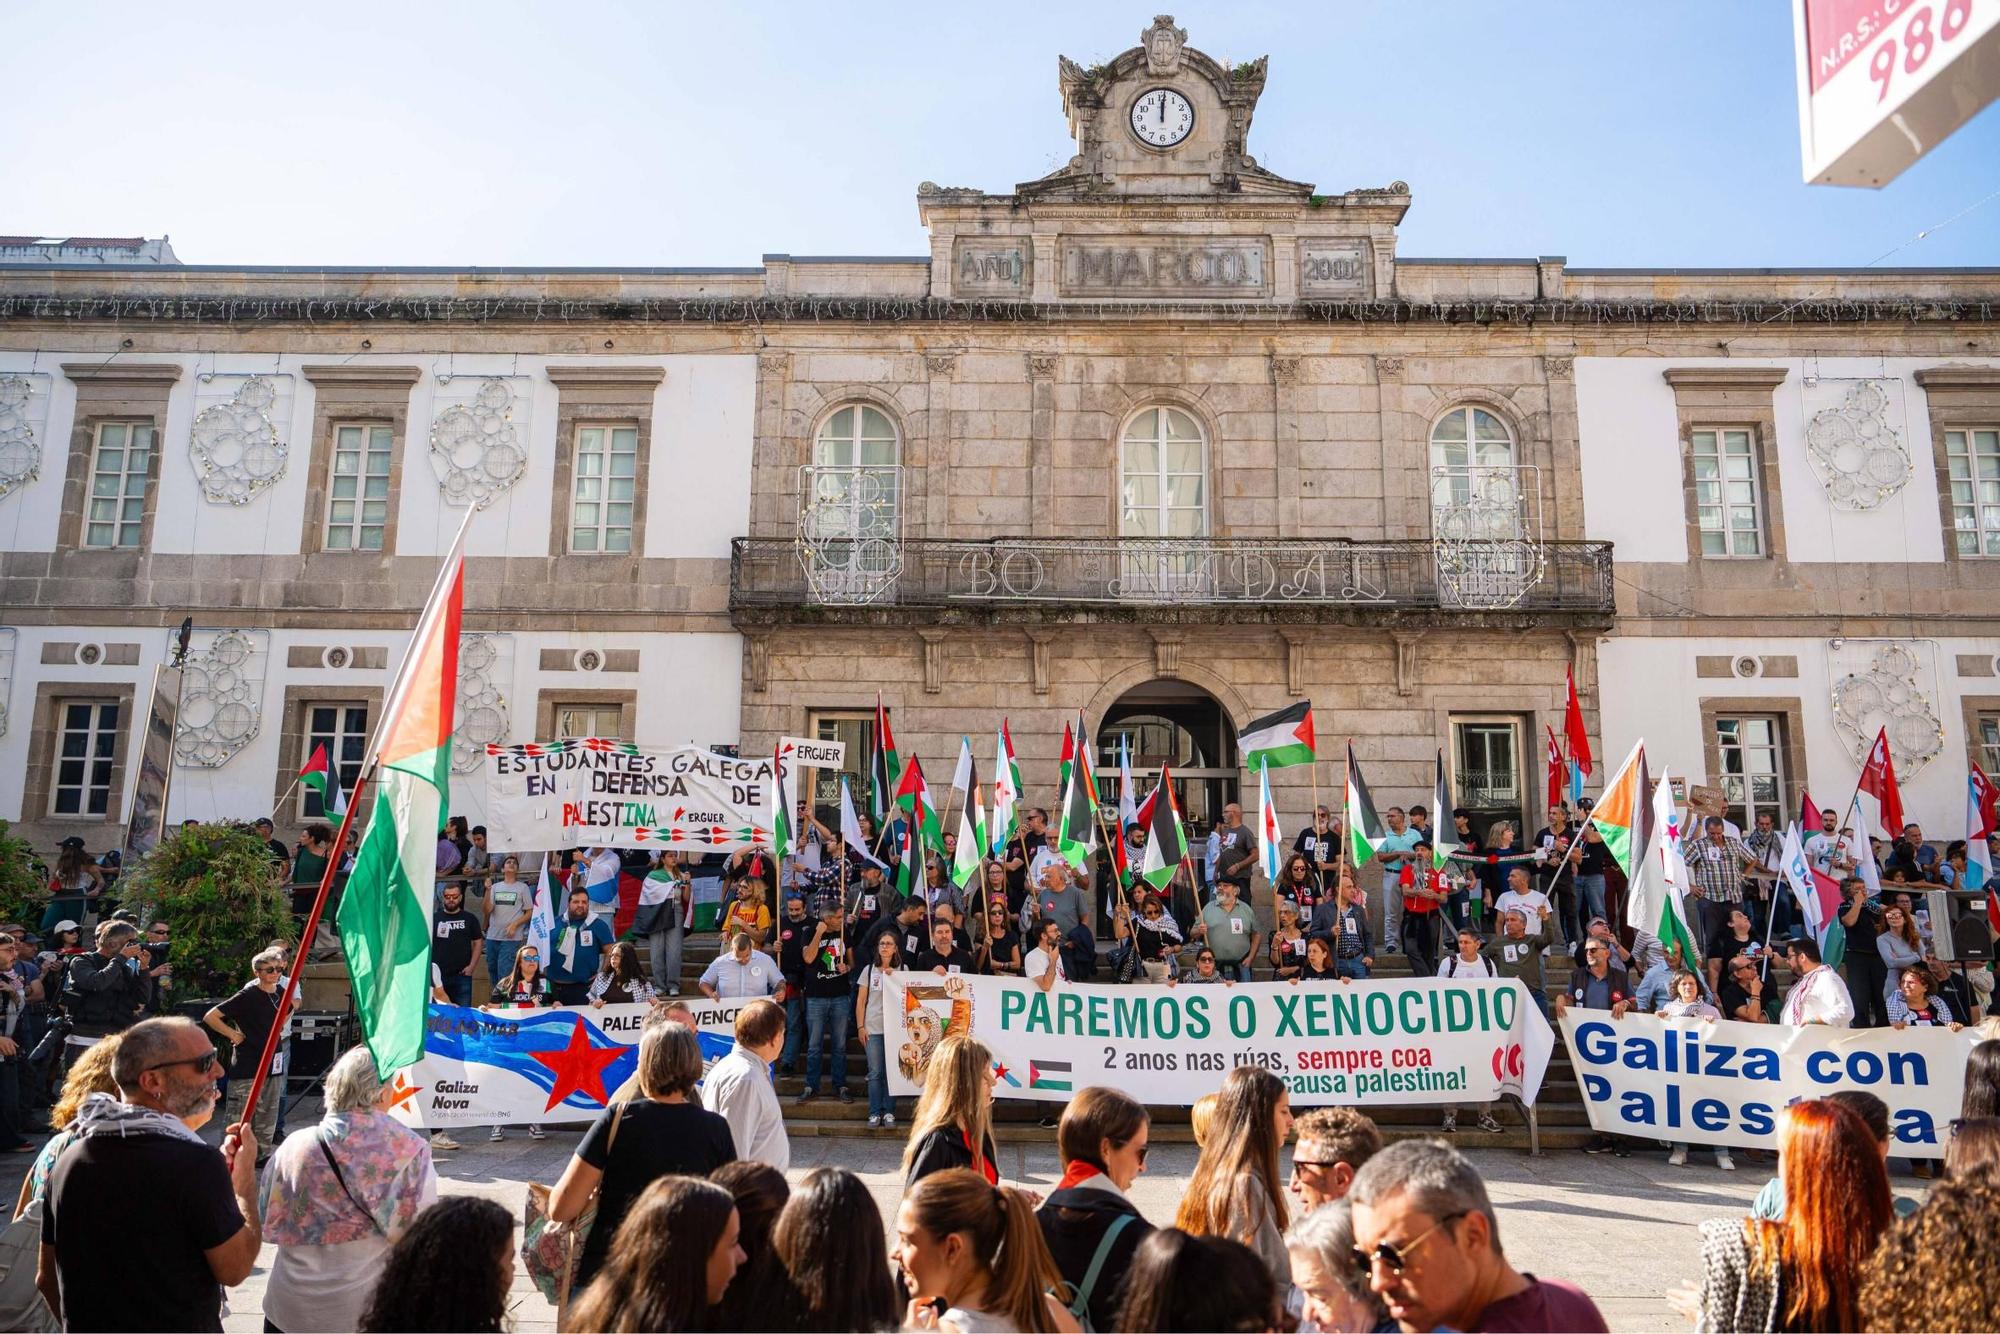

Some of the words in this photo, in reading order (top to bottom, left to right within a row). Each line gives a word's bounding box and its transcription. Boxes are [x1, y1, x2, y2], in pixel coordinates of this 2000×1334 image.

[1140, 105, 1149, 113] 10
[1179, 103, 1184, 111] 2
[1141, 124, 1147, 132] 8
[1149, 131, 1154, 139] 7
[1171, 131, 1176, 139] 5
[1160, 134, 1166, 142] 6
[797, 745, 840, 762] ERGUER
[498, 751, 657, 775] ESTUDANTES
[671, 753, 788, 782] GALEGAS
[526, 775, 556, 797] EN
[592, 772, 689, 797] DEFENSA
[732, 784, 761, 807] DE
[562, 800, 658, 828] PALESTINA
[688, 811, 725, 824] ERGUER
[1002, 989, 1211, 1040] PAREMOS
[1229, 995, 1257, 1039] O
[1273, 986, 1517, 1038] XENOCIDIO
[602, 1015, 646, 1032] PALE
[1104, 1046, 1117, 1070] 2
[1125, 1051, 1178, 1072] anos
[1185, 1053, 1225, 1072] nas
[1234, 1047, 1289, 1074] rúas,
[1297, 1050, 1383, 1074] sempre
[1392, 1048, 1432, 1067] coa
[1574, 1021, 1781, 1082] Galiza
[1806, 1050, 1929, 1086] con
[434, 1079, 479, 1094] Galiza
[1355, 1066, 1467, 1098] palestina!
[432, 1096, 470, 1110] Nova
[1582, 1074, 1938, 1145] Palesa
